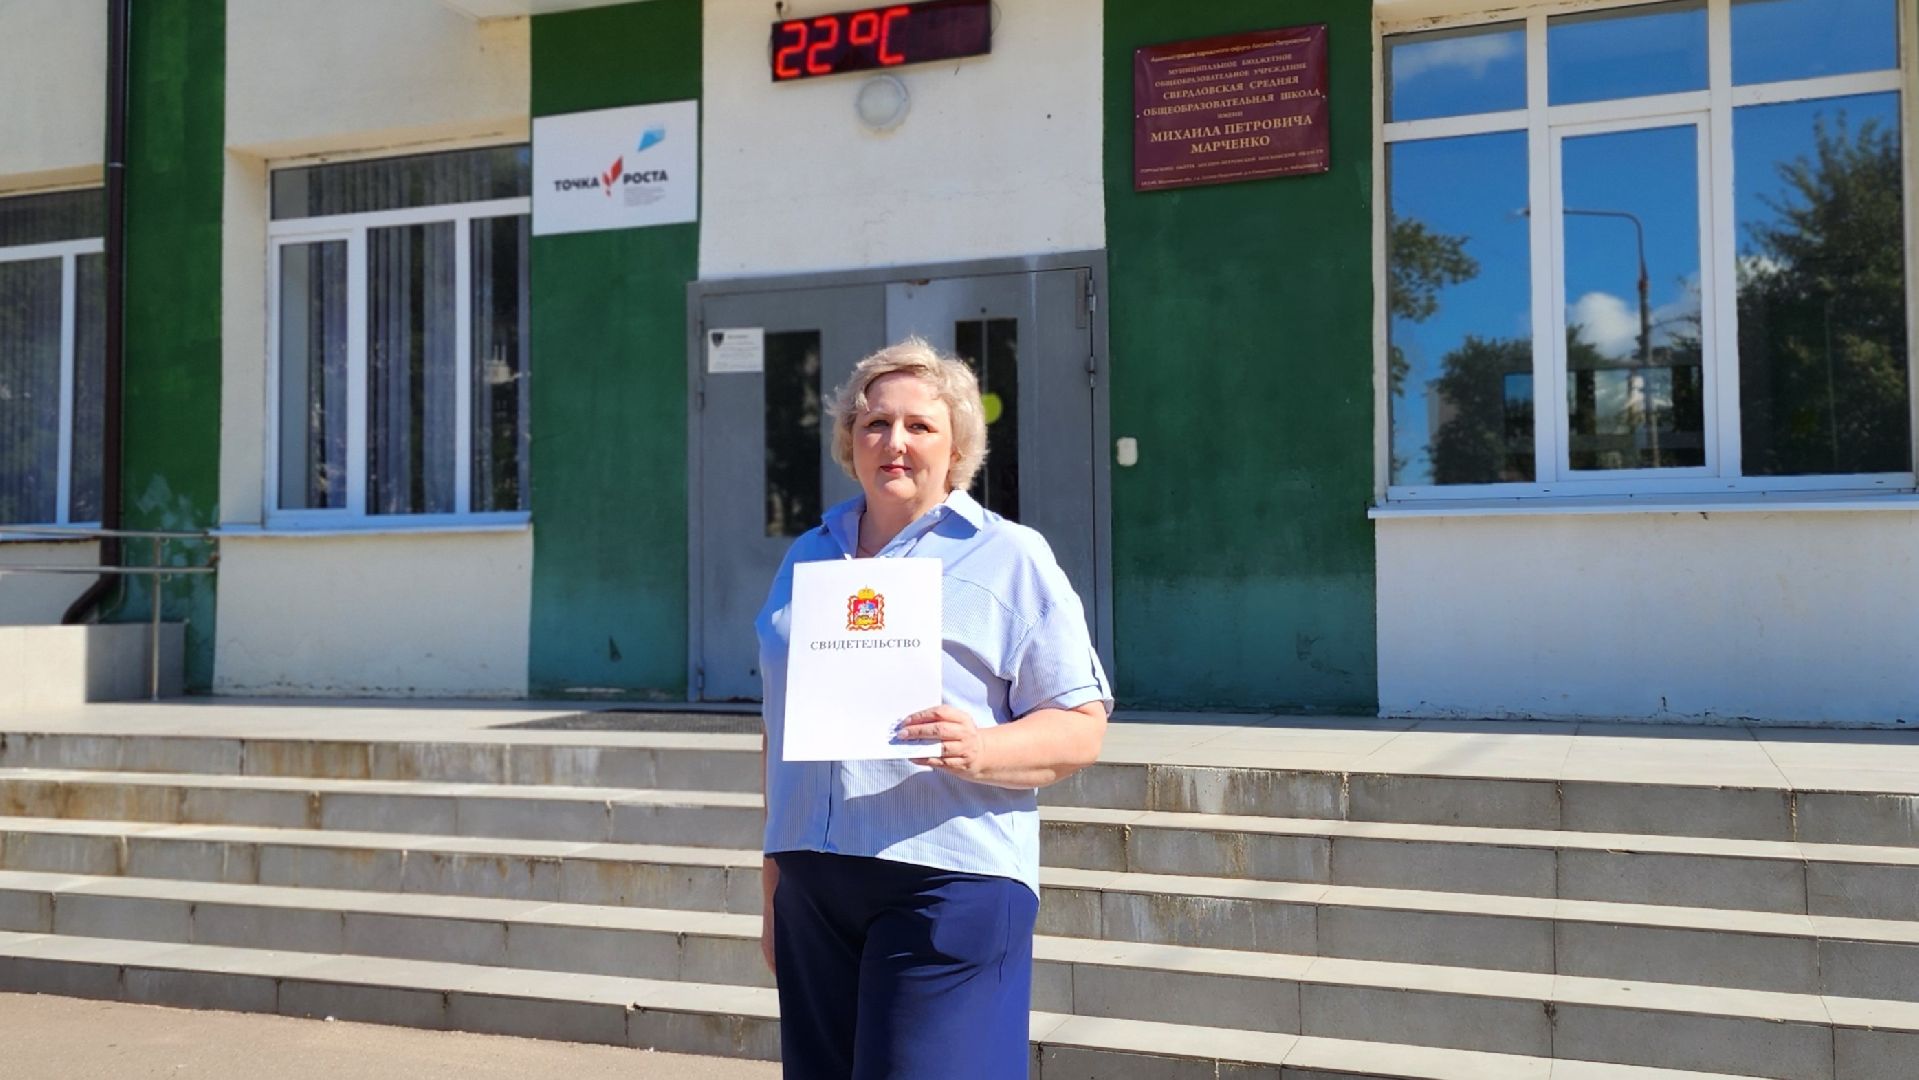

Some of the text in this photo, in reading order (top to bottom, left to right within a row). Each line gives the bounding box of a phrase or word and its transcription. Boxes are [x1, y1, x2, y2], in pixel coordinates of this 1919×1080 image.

[1154, 62, 1307, 88] ОБЩЕОБРАЗОВАТЕЛЬНОЕ УЧРЕЖДЕНИЕ
[1168, 53, 1293, 76] МУНИЦИПАЛЬНОЕ БЮДЖЕТНОЕ
[1163, 75, 1299, 100] СВЕРДЛОВСКАЯ СРЕДНЯЯ
[1143, 88, 1321, 117] ОБЩЕОБРАЗОВАТЕЛЬНАЯ ШКОЛА
[1150, 114, 1313, 143] МИХАИЛА ПЕТРОВИЧА
[1190, 135, 1271, 154] МАРЧЕНКО
[554, 170, 668, 192] ТОЧКА РОСТА
[810, 638, 921, 650] СВИДЕТЕЛЬСТВО
